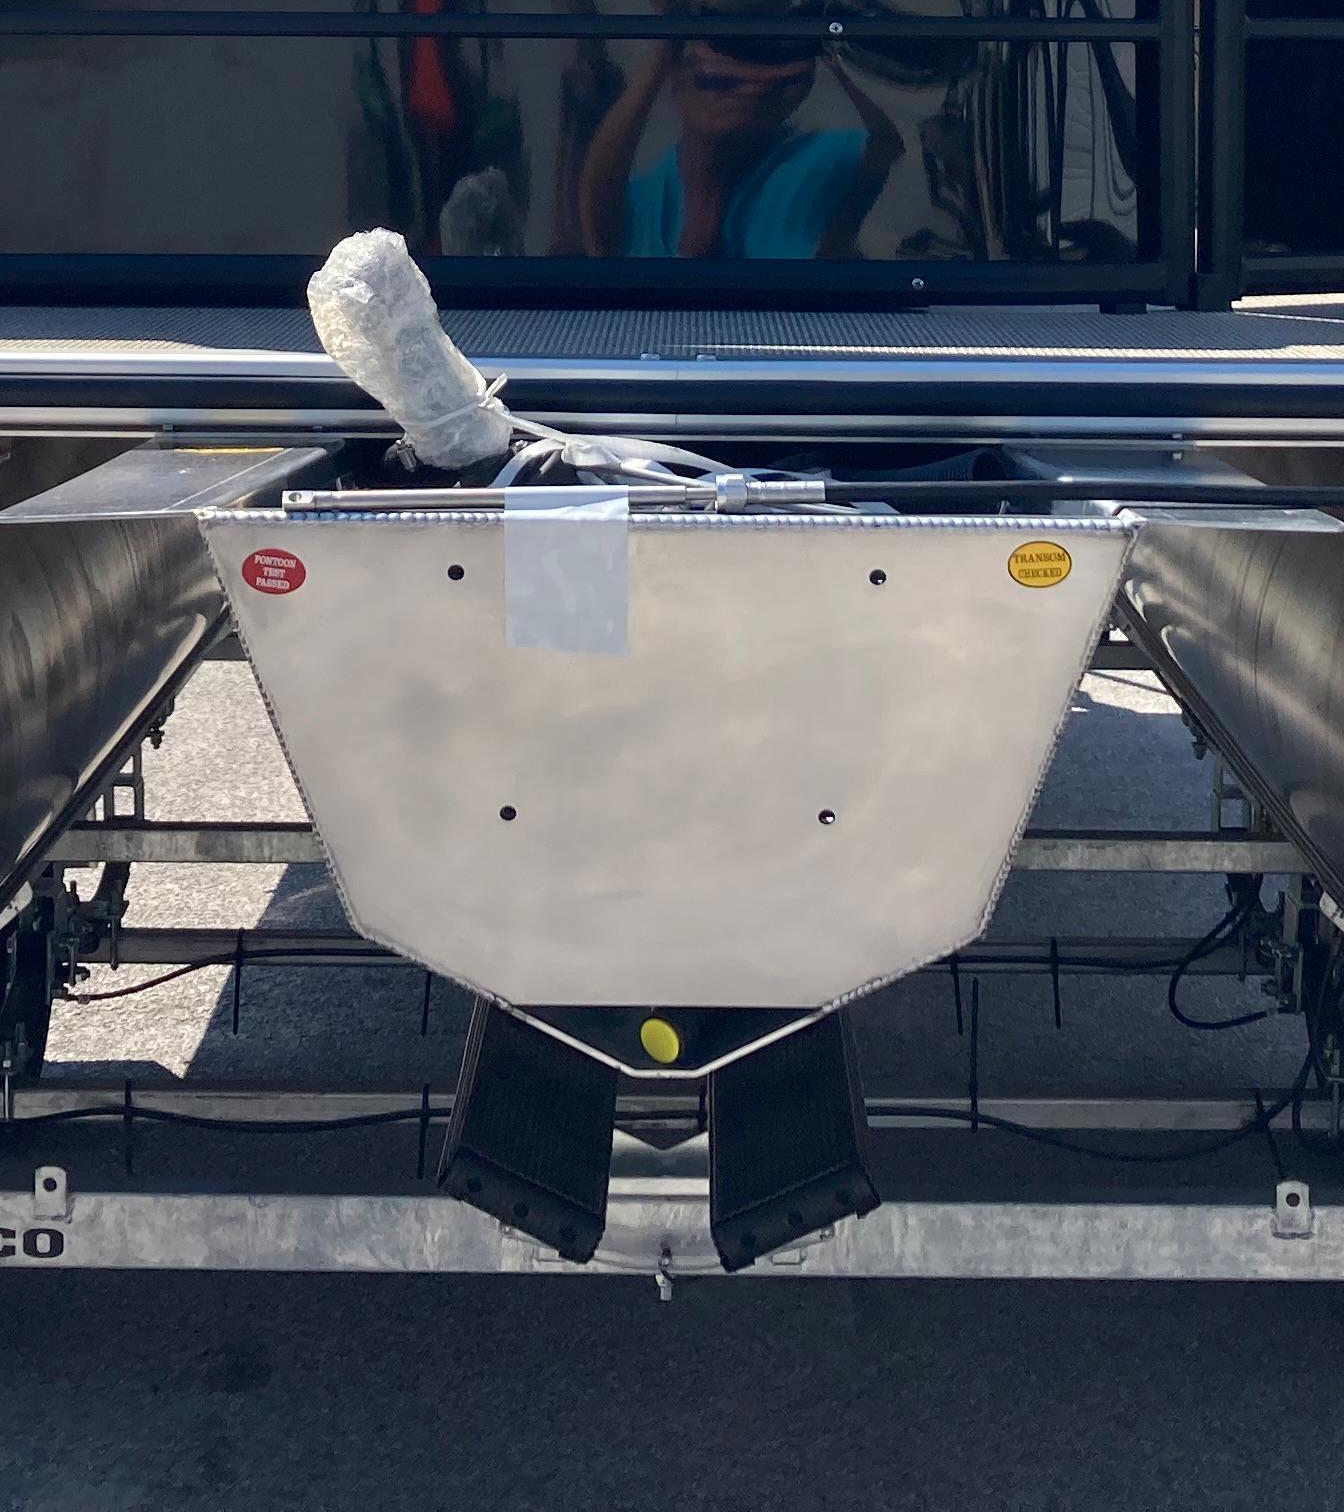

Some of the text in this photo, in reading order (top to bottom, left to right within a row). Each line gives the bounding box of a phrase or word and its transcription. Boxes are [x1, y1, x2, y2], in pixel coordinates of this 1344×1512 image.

[254, 554, 297, 569] PONTOON
[1014, 552, 1066, 564] TRANSOM
[262, 566, 286, 578] TEST
[1018, 567, 1062, 578] CHECKED
[255, 577, 290, 589] PASSED
